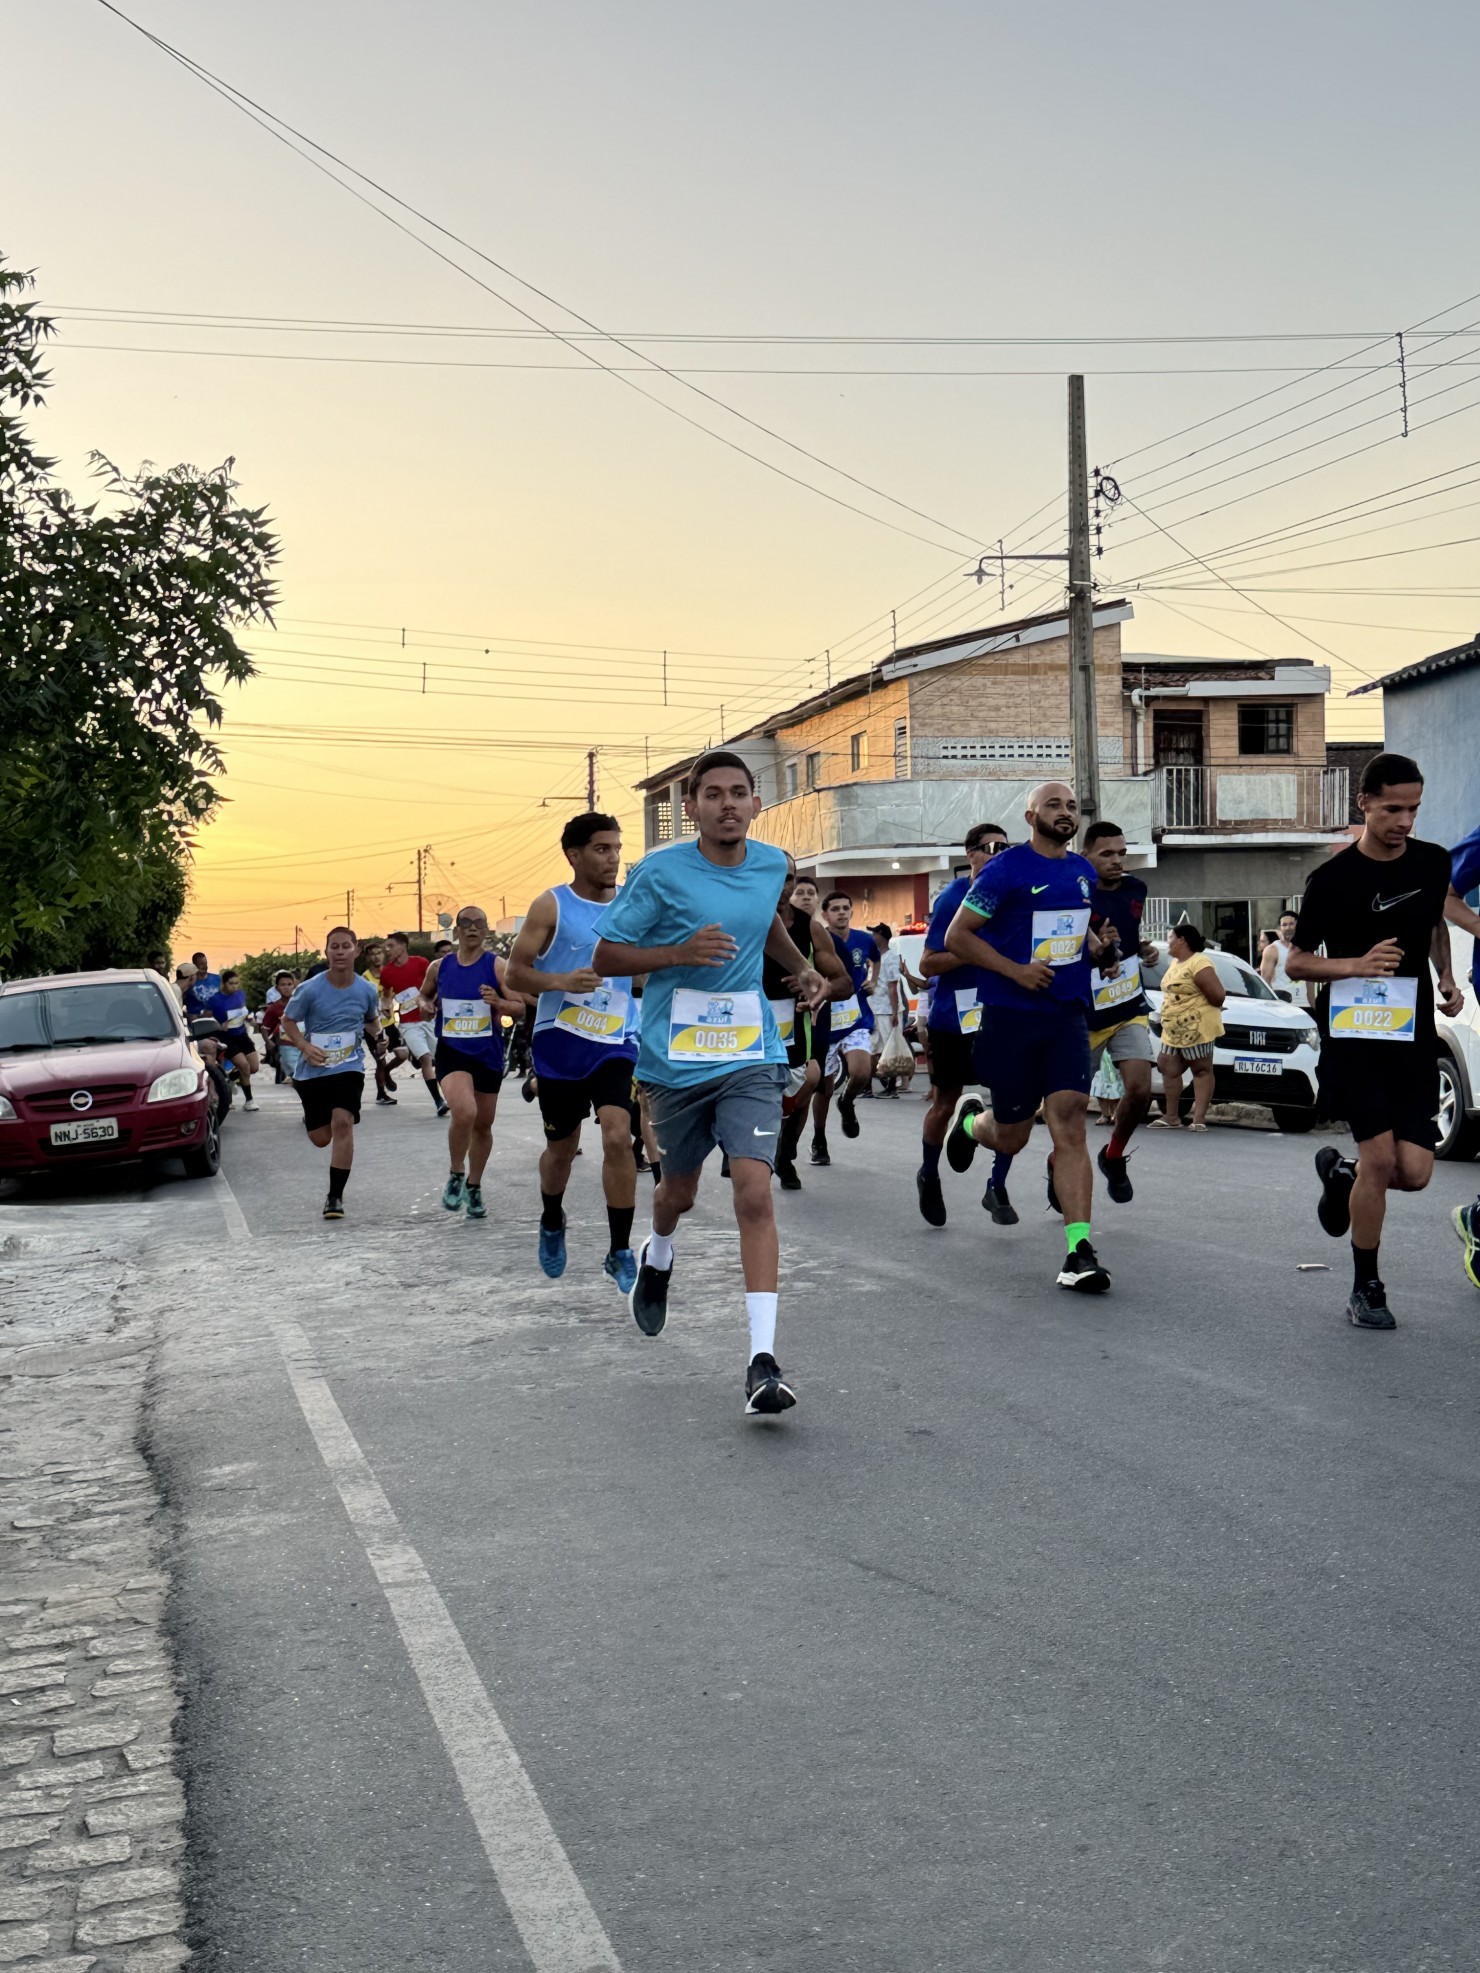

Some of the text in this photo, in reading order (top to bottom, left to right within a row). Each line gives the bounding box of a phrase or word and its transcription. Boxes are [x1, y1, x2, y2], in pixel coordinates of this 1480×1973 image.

[576, 1010, 608, 1031] 0044
[1354, 1009, 1392, 1027] 0022
[695, 1030, 738, 1049] 0035
[1250, 1030, 1267, 1046] FIAT
[54, 1125, 115, 1143] NNJ-5630
